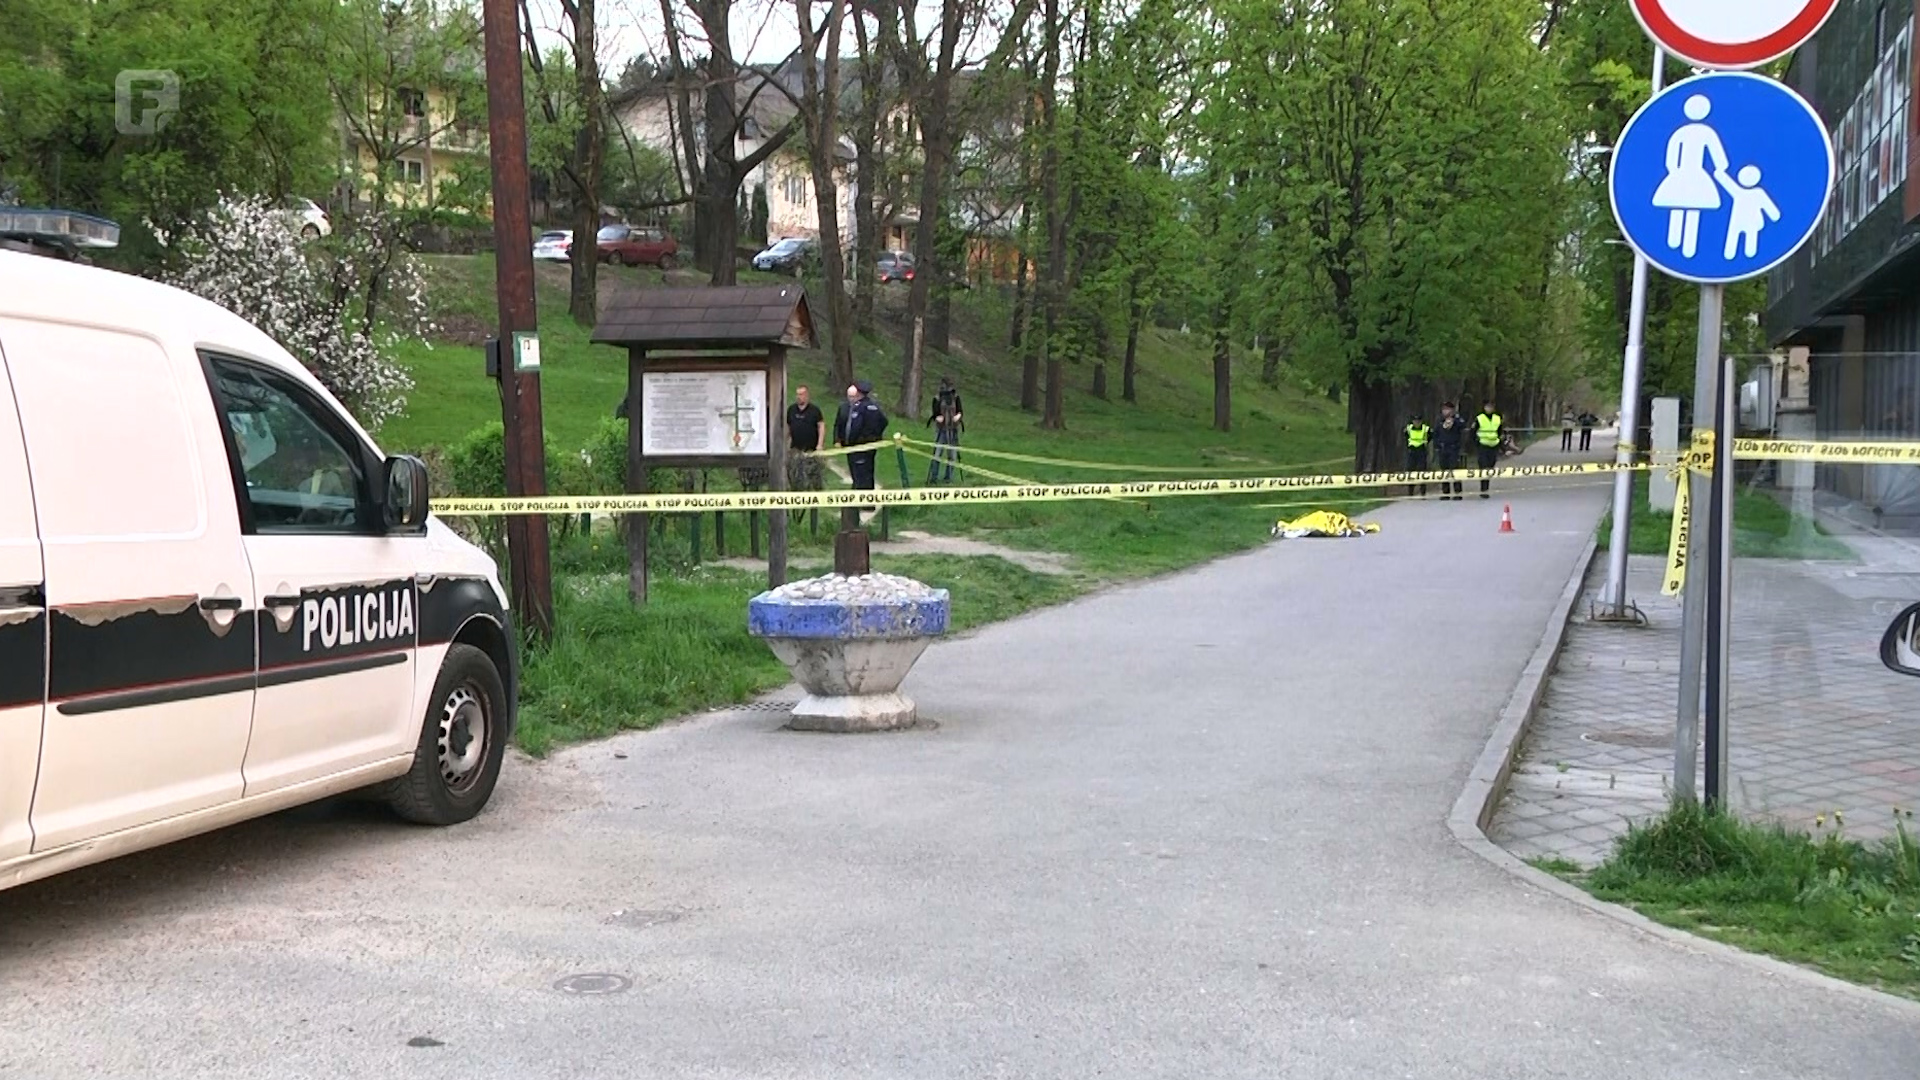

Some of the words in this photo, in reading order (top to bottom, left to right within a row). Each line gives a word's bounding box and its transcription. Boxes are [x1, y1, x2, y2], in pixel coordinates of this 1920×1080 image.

[1692, 453, 1711, 464] OP
[454, 503, 495, 511] POLICIJA
[501, 502, 524, 511] STOP
[527, 502, 569, 511] POLICIJA
[576, 502, 601, 510] STOP
[604, 500, 648, 509] POLICIJA
[656, 498, 681, 508] STOP
[684, 498, 731, 507] POLICIJA
[739, 497, 766, 505] STOP
[769, 496, 819, 505] POLICIJA
[826, 494, 856, 504] STOP
[860, 493, 912, 503] POLICIJA
[920, 492, 950, 501] STOP
[954, 489, 1008, 499] POLICIJA
[1017, 488, 1048, 498] STOP
[1053, 485, 1111, 496] POLICIJA
[1120, 484, 1154, 493] STOP
[1158, 480, 1219, 492] POLICIJA
[1229, 480, 1264, 488] STOP
[1269, 476, 1334, 487] POLICIJA
[1344, 473, 1382, 484] STOP
[1387, 471, 1454, 482] POLICIJA
[1467, 469, 1506, 478] STOP
[303, 588, 414, 651] POLICIJA
